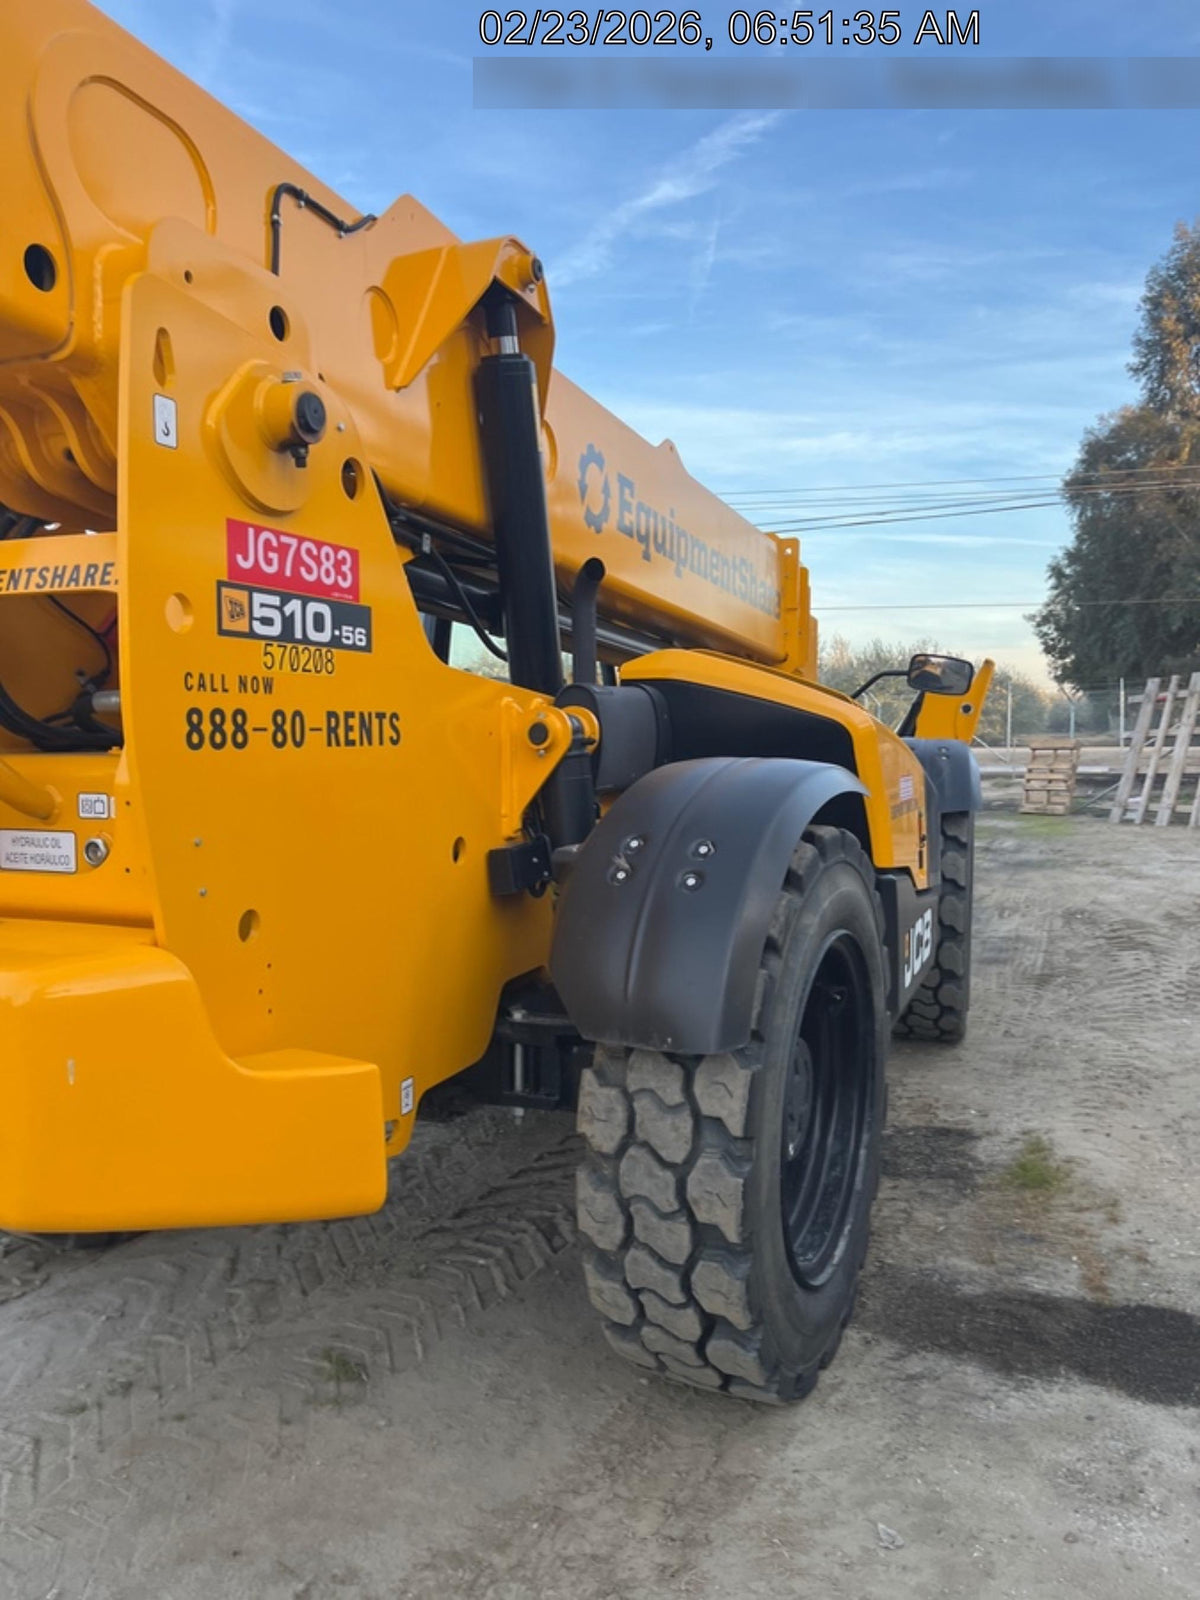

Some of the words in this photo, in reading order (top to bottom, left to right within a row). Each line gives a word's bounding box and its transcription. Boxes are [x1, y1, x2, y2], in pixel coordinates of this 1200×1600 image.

[235, 527, 353, 588] JG7S83
[263, 643, 335, 674] 570208
[184, 671, 230, 693] CALL
[238, 675, 274, 694] NOW
[185, 707, 402, 751] 888-80-RENTS
[904, 908, 932, 989] JCB
